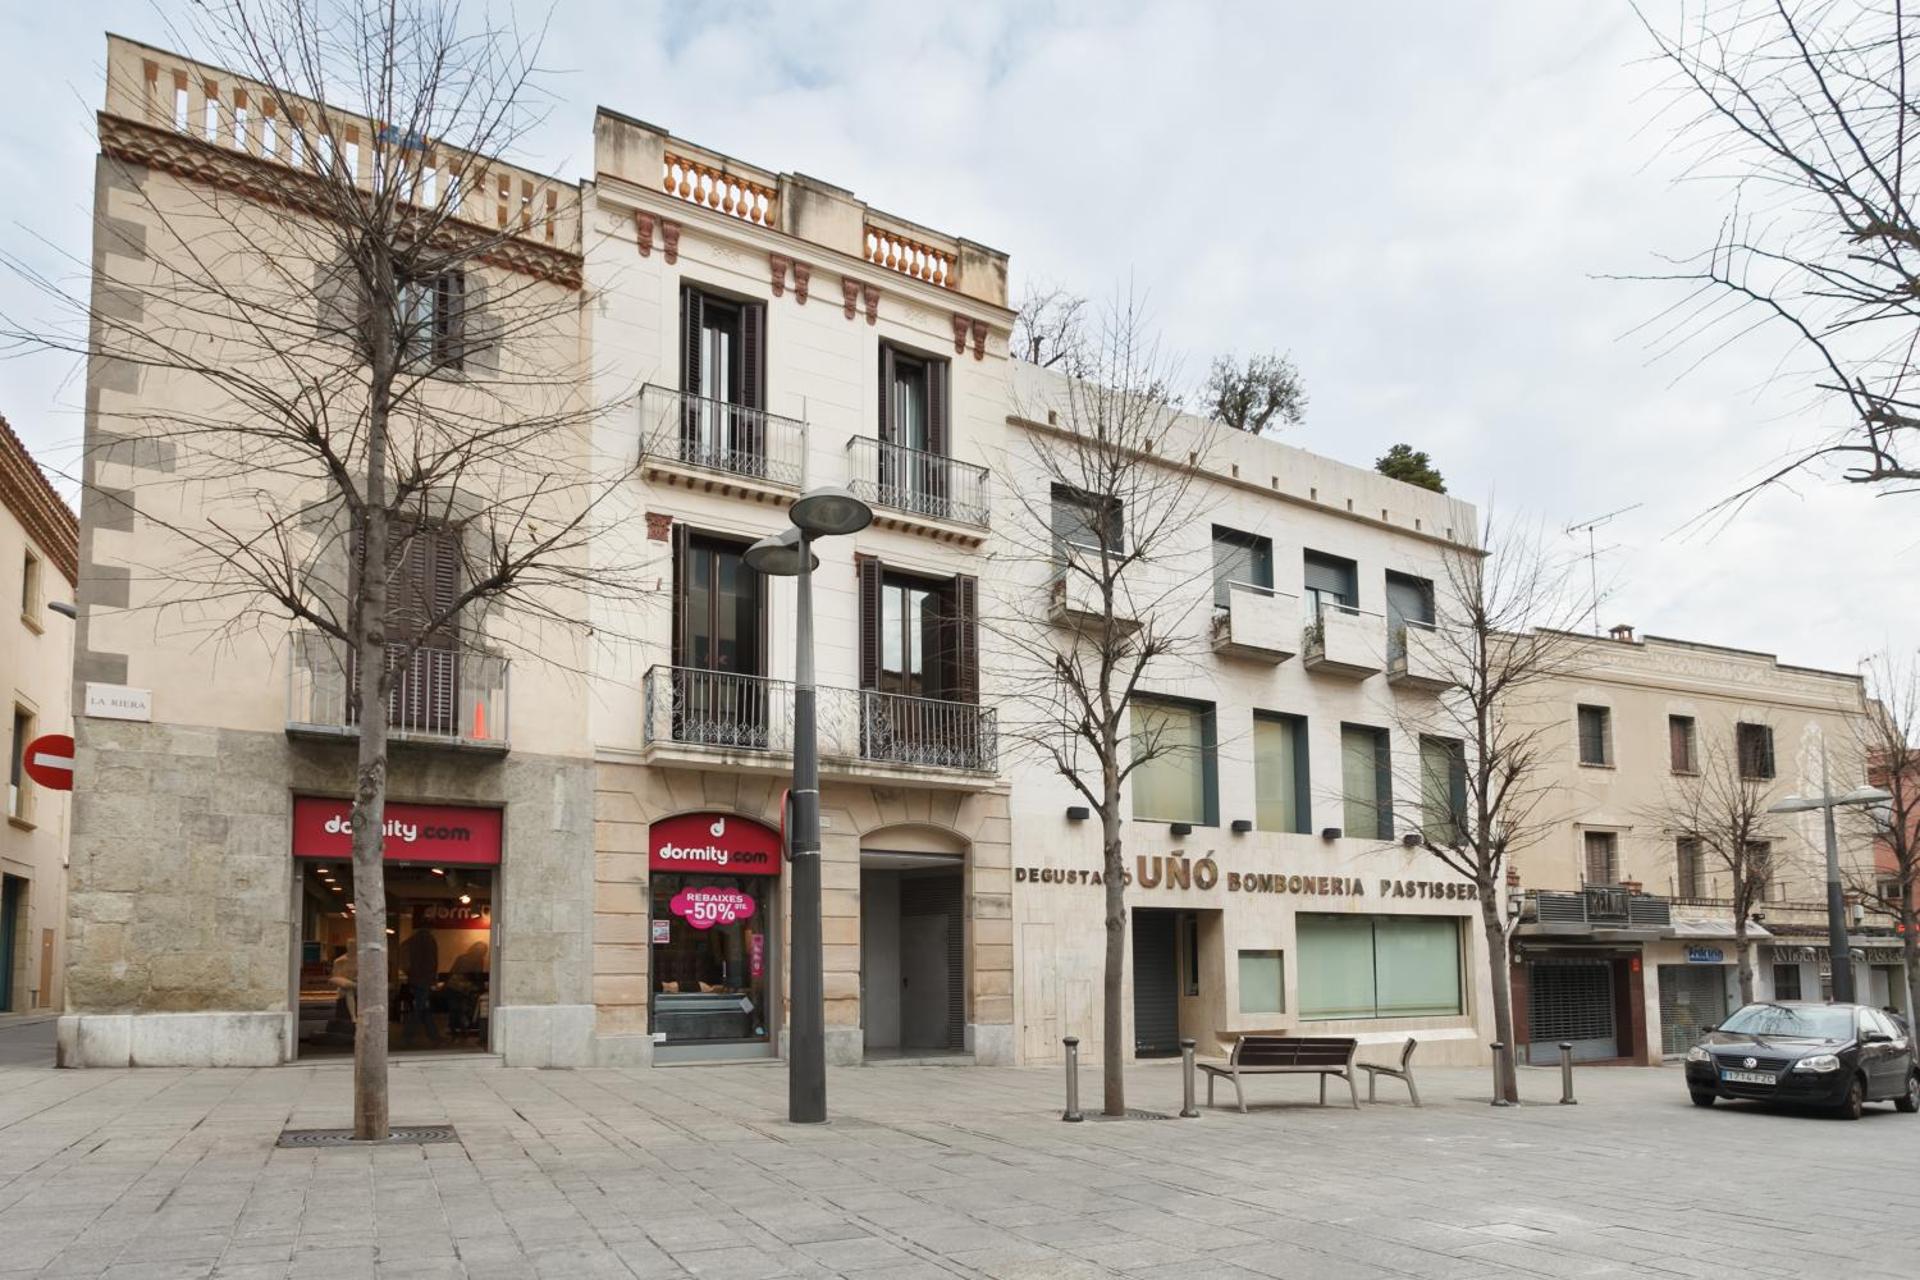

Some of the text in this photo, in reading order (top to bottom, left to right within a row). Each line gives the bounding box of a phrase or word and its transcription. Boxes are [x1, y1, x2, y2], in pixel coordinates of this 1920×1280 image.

[91, 697, 146, 709] LA RIERA
[325, 815, 470, 842] doity.com
[659, 842, 768, 865] dormity.com
[1015, 867, 1133, 887] DEGUSTAÓ
[1136, 849, 1218, 890] UÑÓ
[1227, 872, 1365, 897] BOMBONERIA
[686, 893, 744, 903] REBAIXES
[684, 902, 735, 920] -50%
